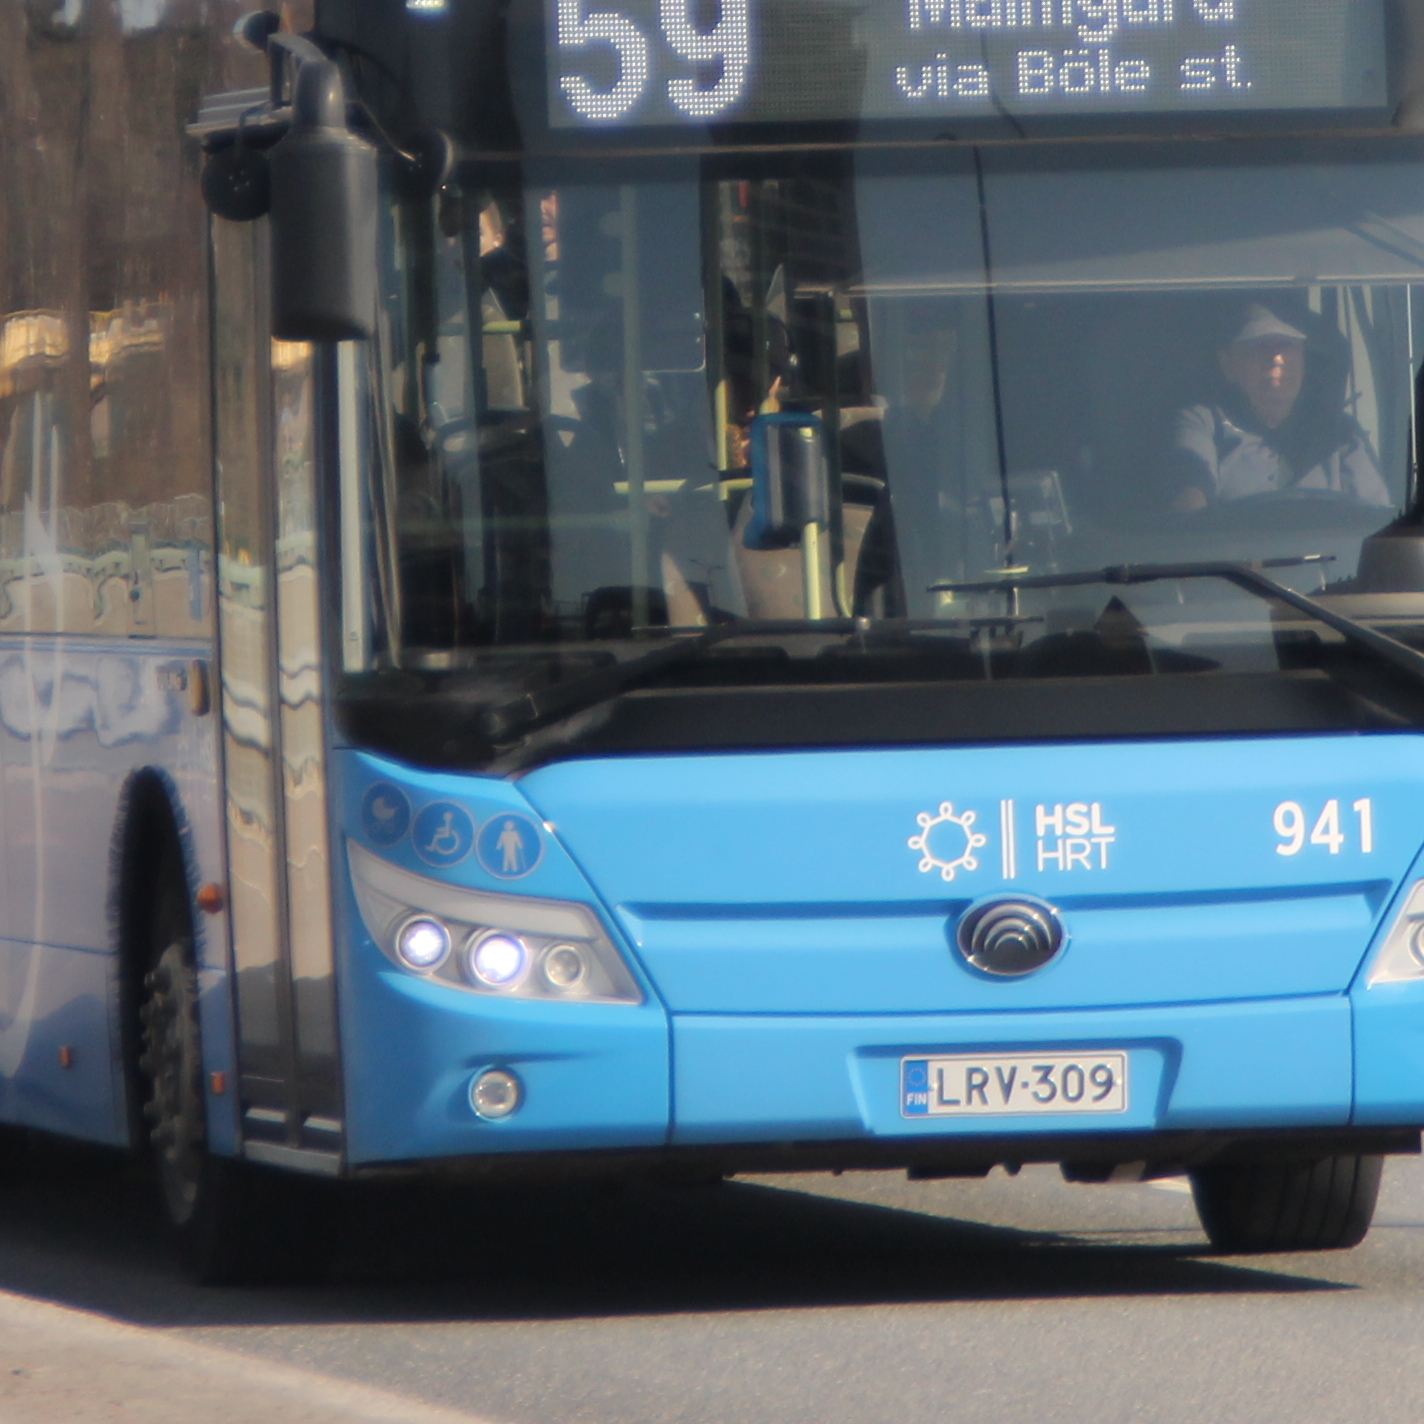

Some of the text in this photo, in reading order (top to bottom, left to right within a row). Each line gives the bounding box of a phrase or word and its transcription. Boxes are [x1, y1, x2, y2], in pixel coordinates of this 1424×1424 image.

[895, 44, 1253, 98] via Böle st.
[1036, 802, 1116, 836] HSL
[1274, 797, 1373, 856] 941
[1036, 836, 1116, 872] HRT
[907, 1093, 927, 1106] FIN
[937, 1064, 1115, 1106] LRV-309
